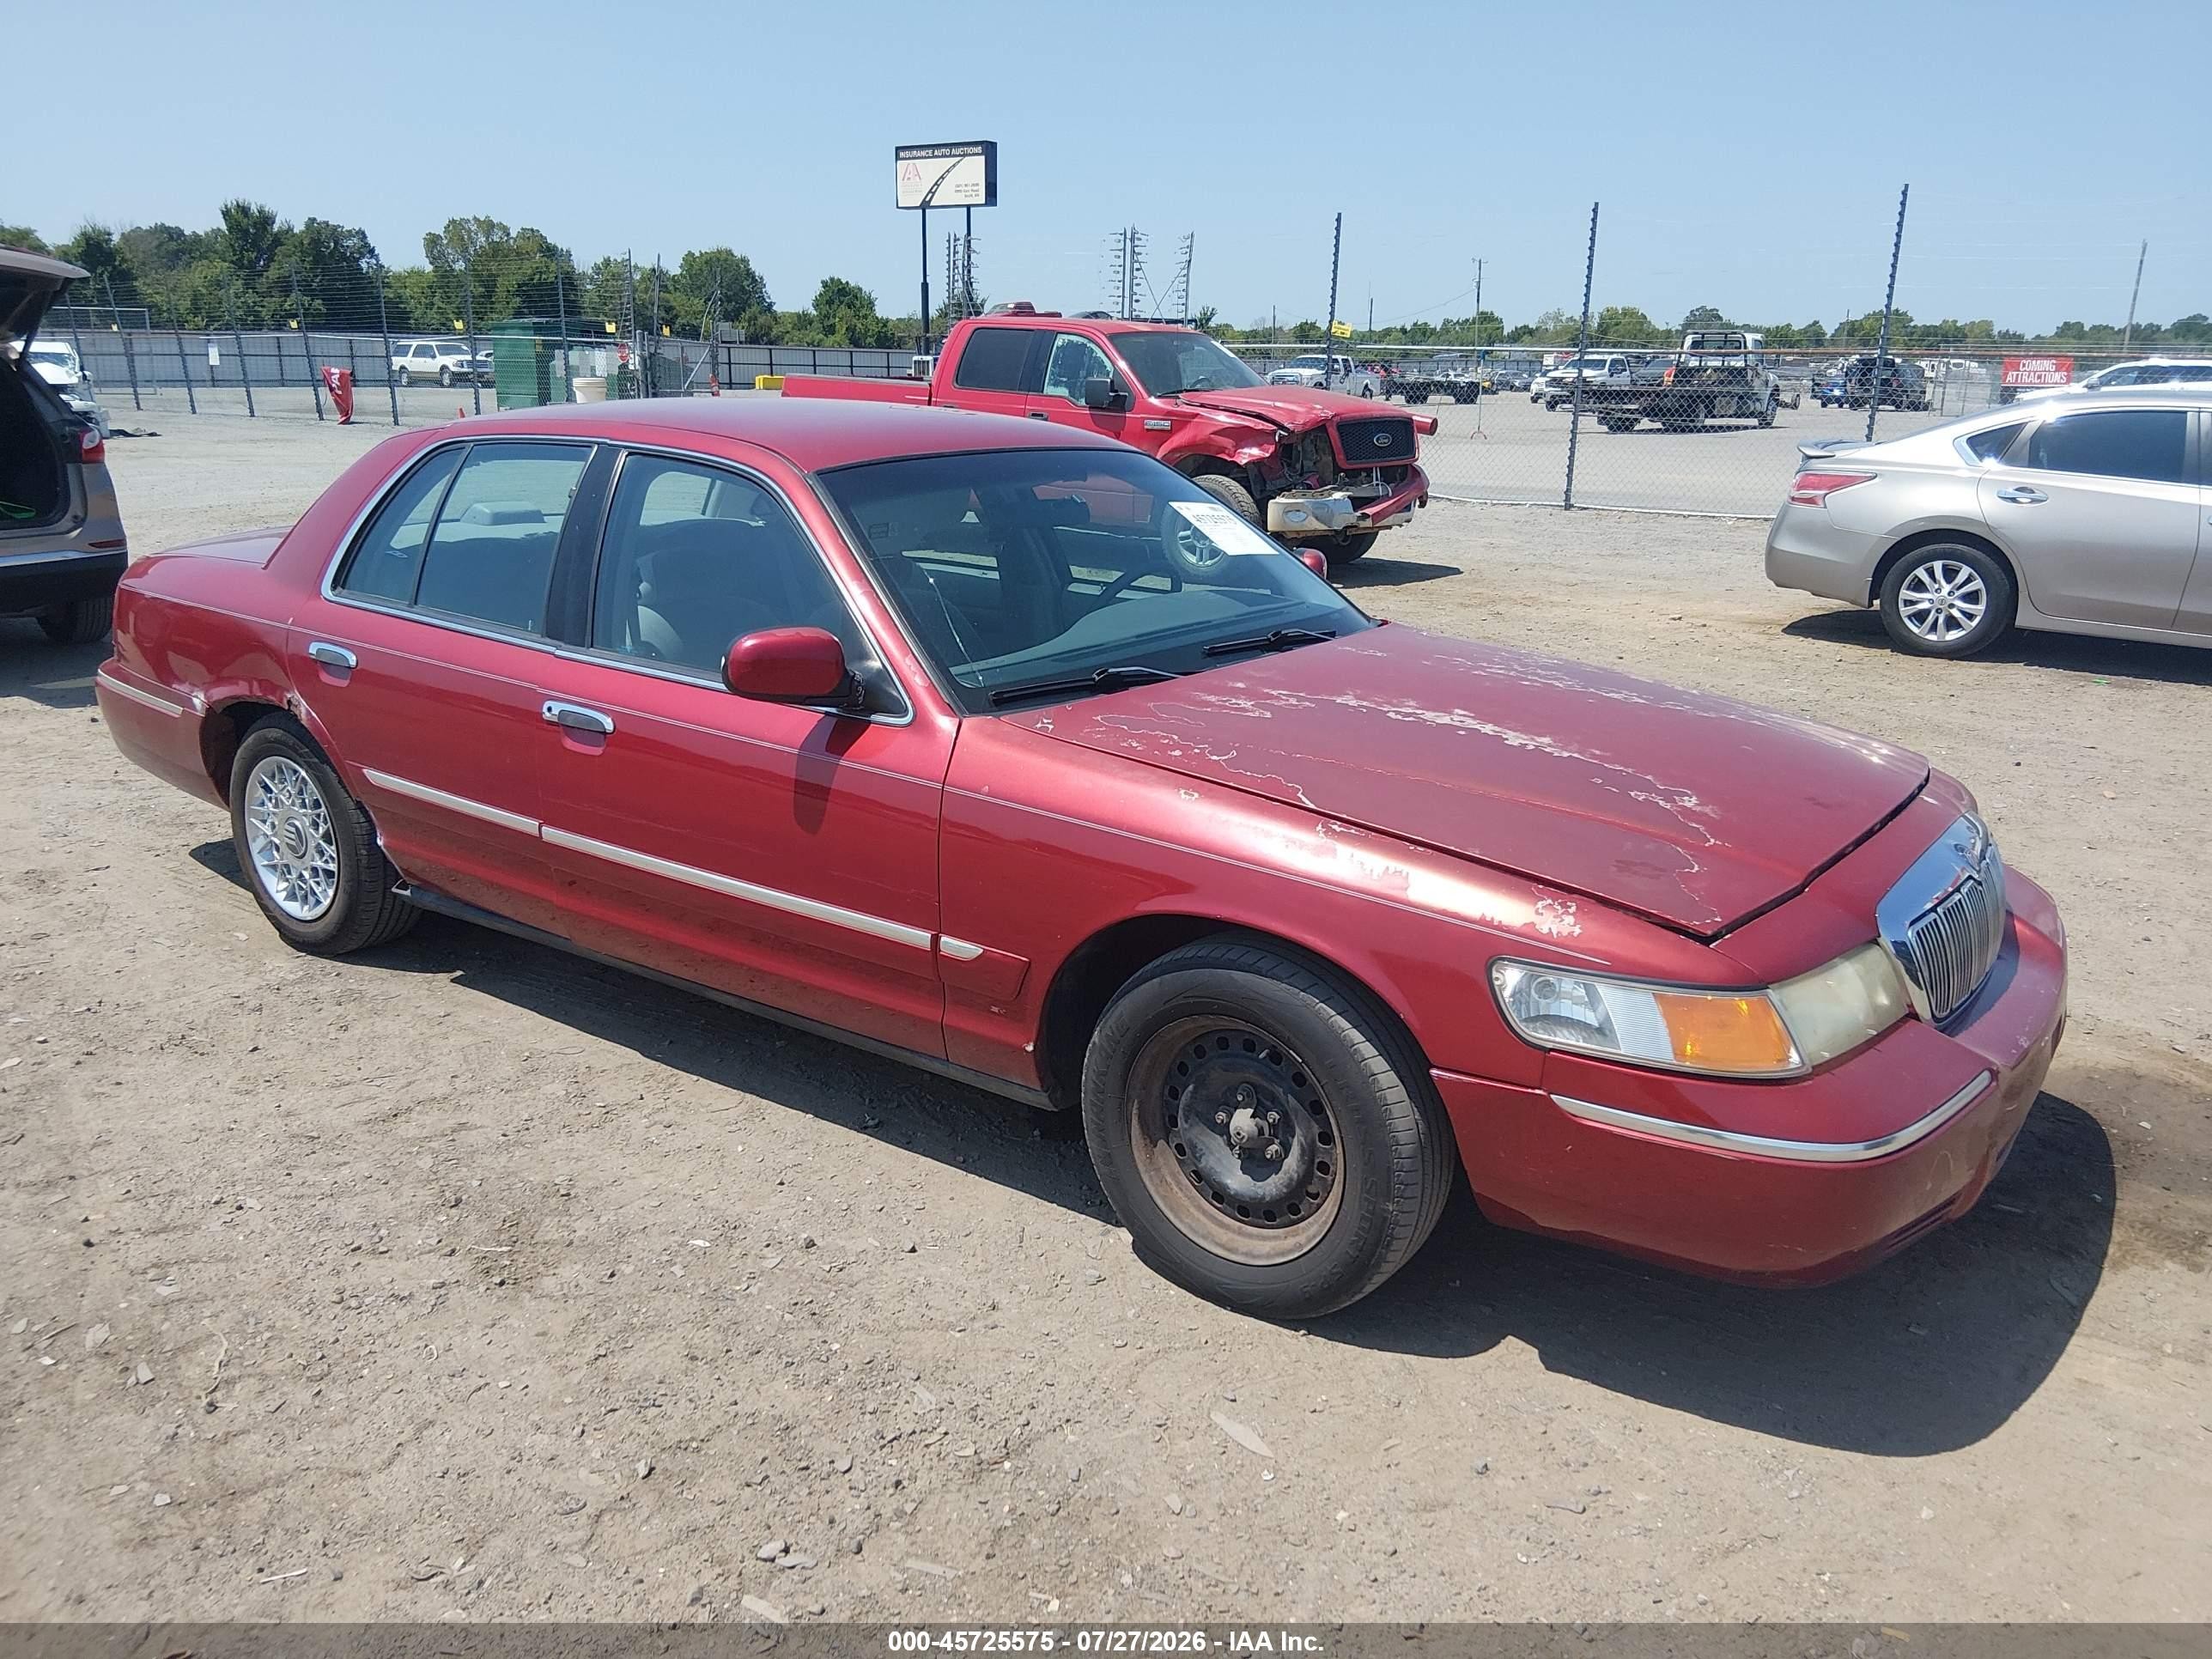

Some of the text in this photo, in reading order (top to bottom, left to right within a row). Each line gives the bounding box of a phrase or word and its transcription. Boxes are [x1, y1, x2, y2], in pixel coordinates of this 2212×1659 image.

[899, 149, 933, 158] INSURANCE
[933, 148, 951, 156] AUTO
[2019, 360, 2057, 371] COMING
[2005, 372, 2068, 383] ATTRACTIONS
[1345, 1176, 1380, 1262] SPORT
